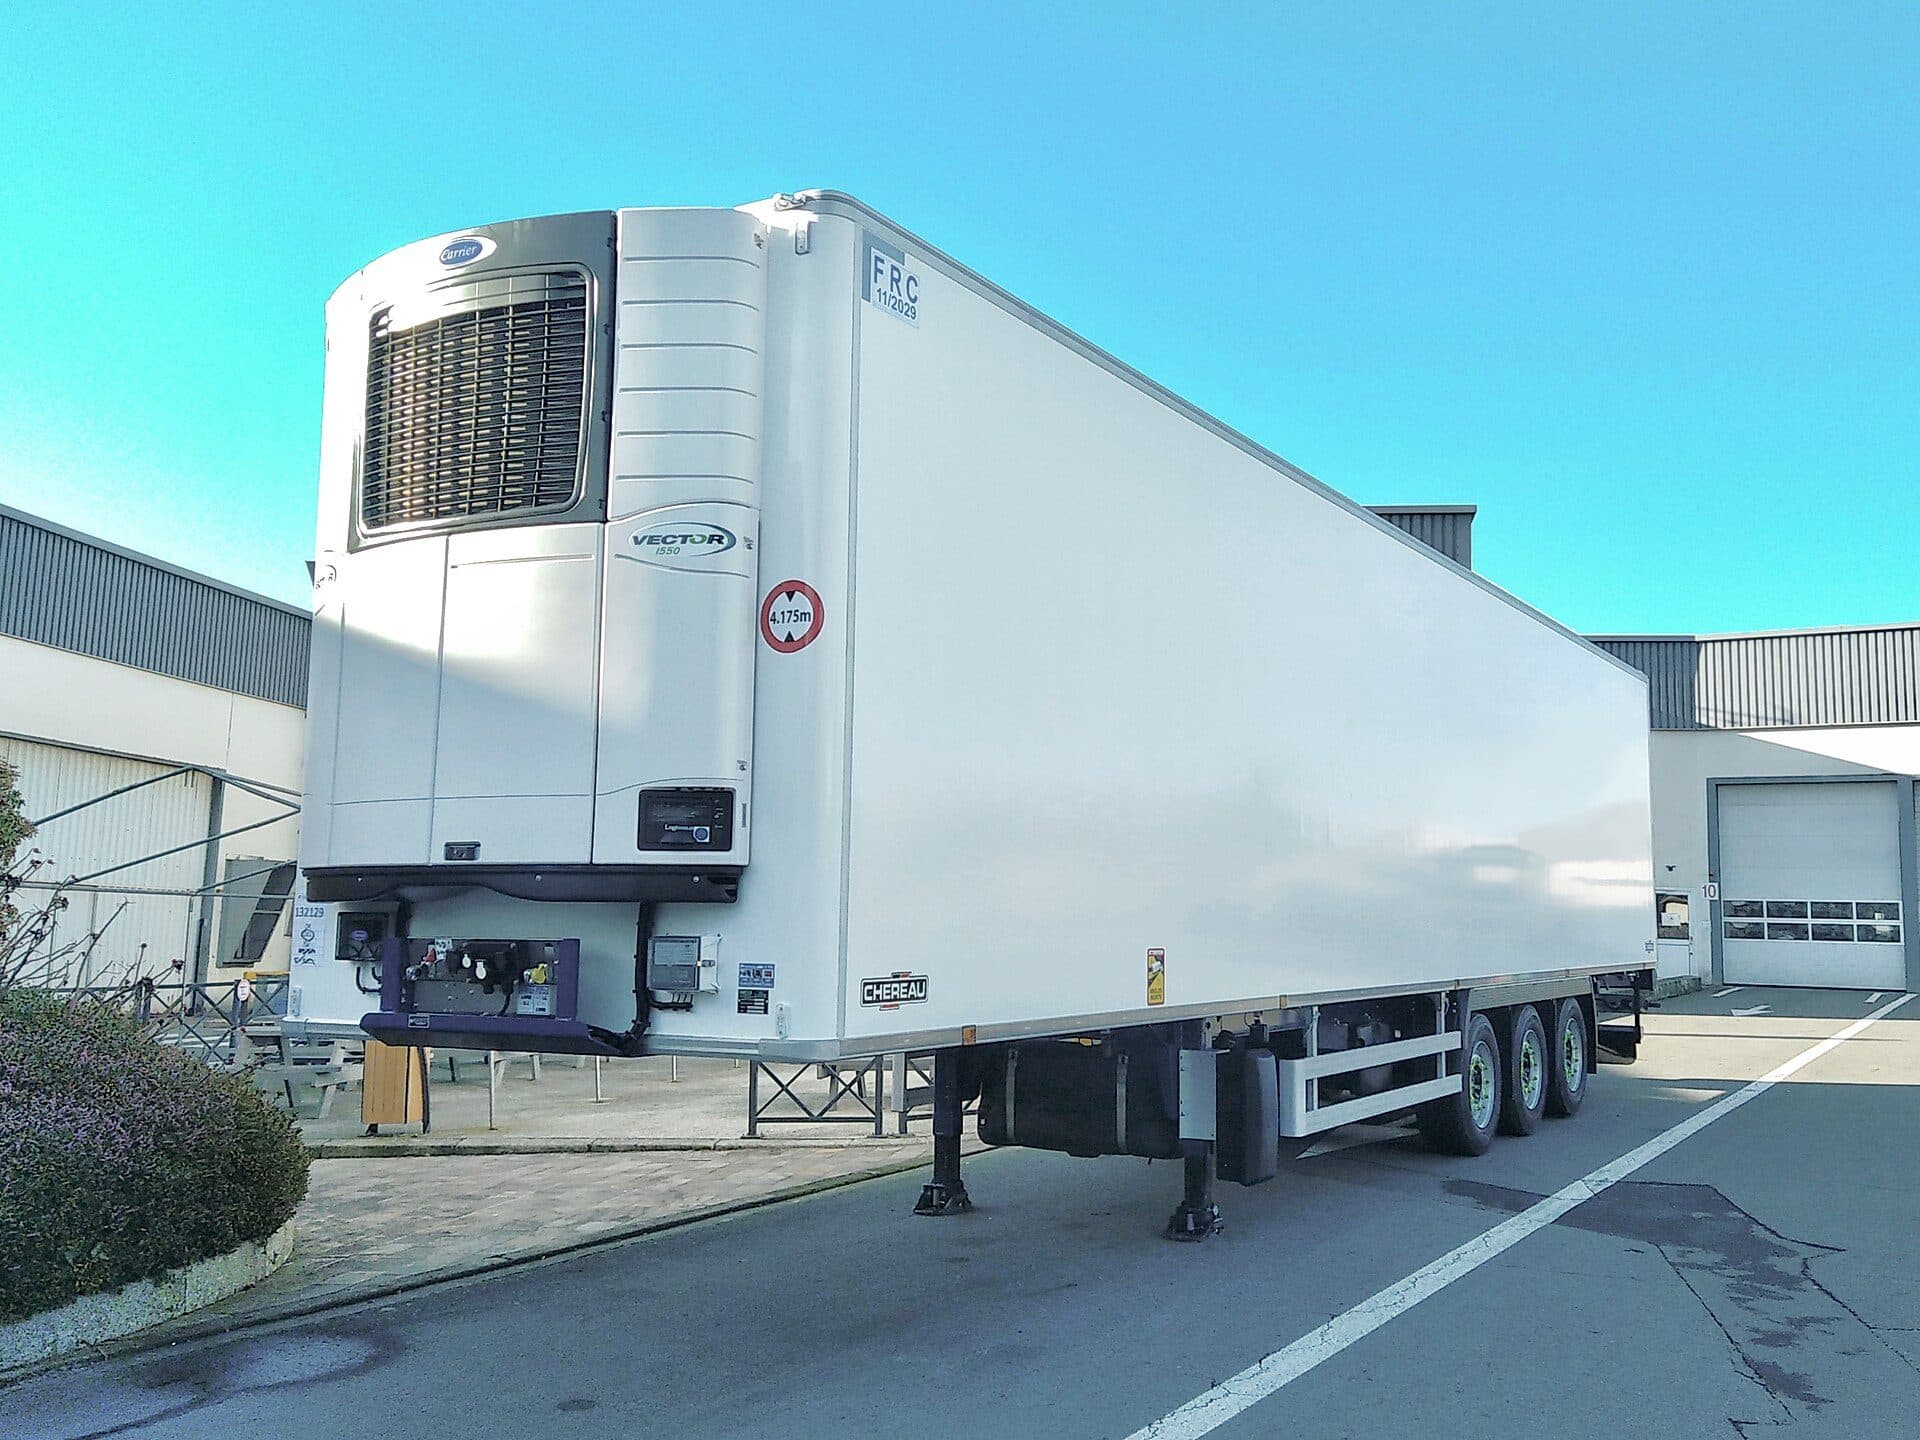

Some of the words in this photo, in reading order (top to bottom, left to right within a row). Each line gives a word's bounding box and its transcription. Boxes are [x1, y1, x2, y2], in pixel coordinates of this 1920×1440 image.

[440, 244, 478, 261] Carrier
[876, 287, 917, 321] 11/2029
[632, 534, 726, 546] VECTOR
[655, 546, 681, 556] 1550
[769, 609, 812, 625] 4.175m
[1702, 884, 1717, 899] 10
[295, 907, 325, 918] 132129
[864, 980, 926, 1002] CHEREAU
